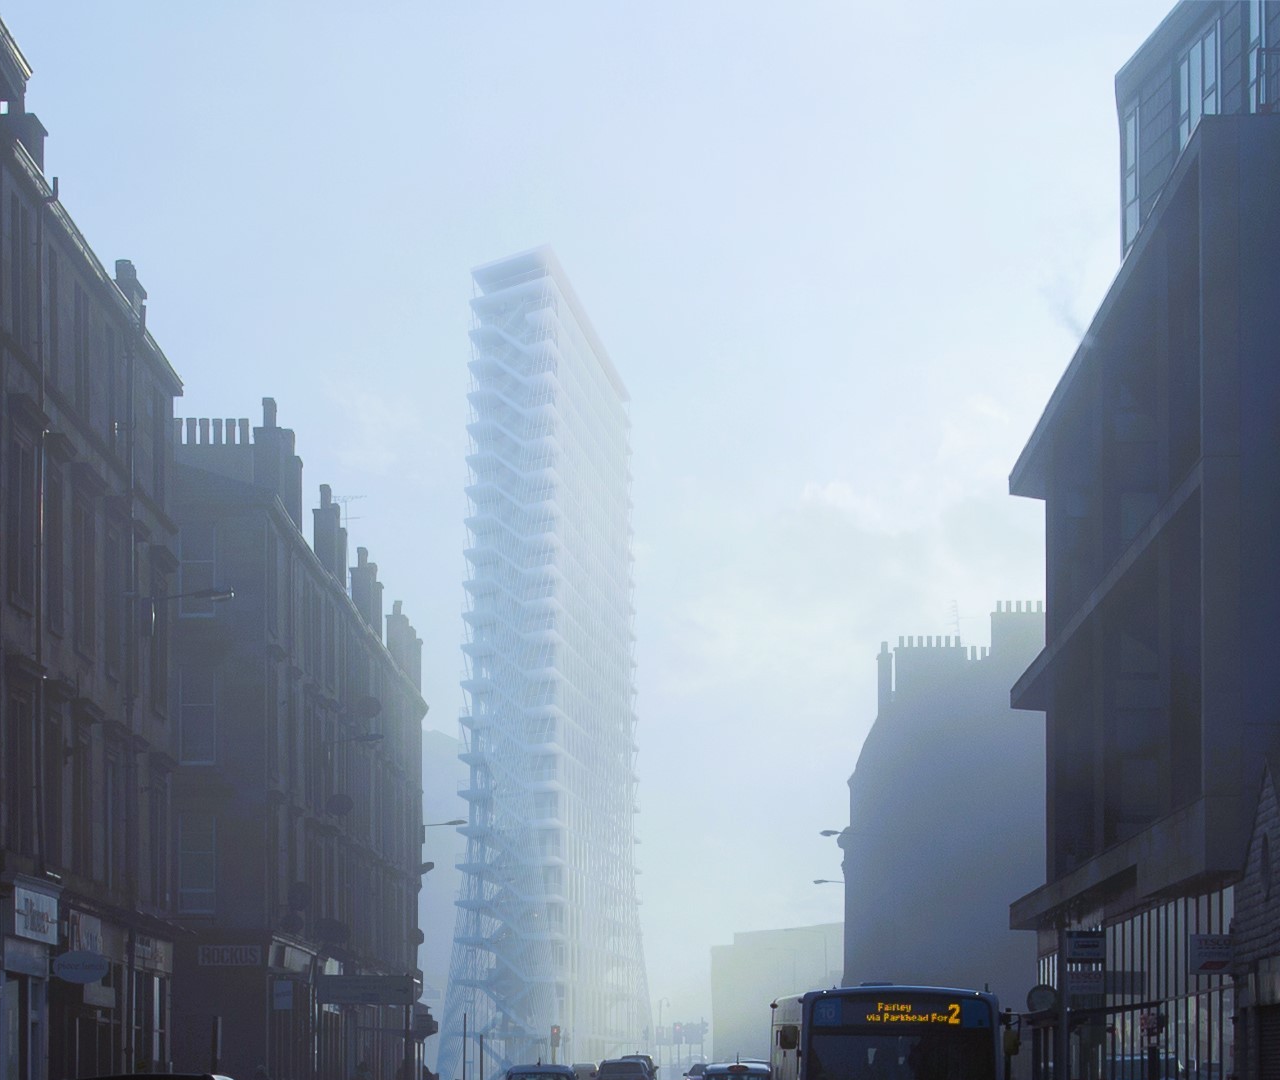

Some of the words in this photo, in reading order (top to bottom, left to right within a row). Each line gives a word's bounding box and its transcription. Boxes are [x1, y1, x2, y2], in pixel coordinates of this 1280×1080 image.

[866, 1014, 880, 1022] via
[883, 1013, 928, 1023] Parkhead
[948, 1003, 960, 1025] 2
